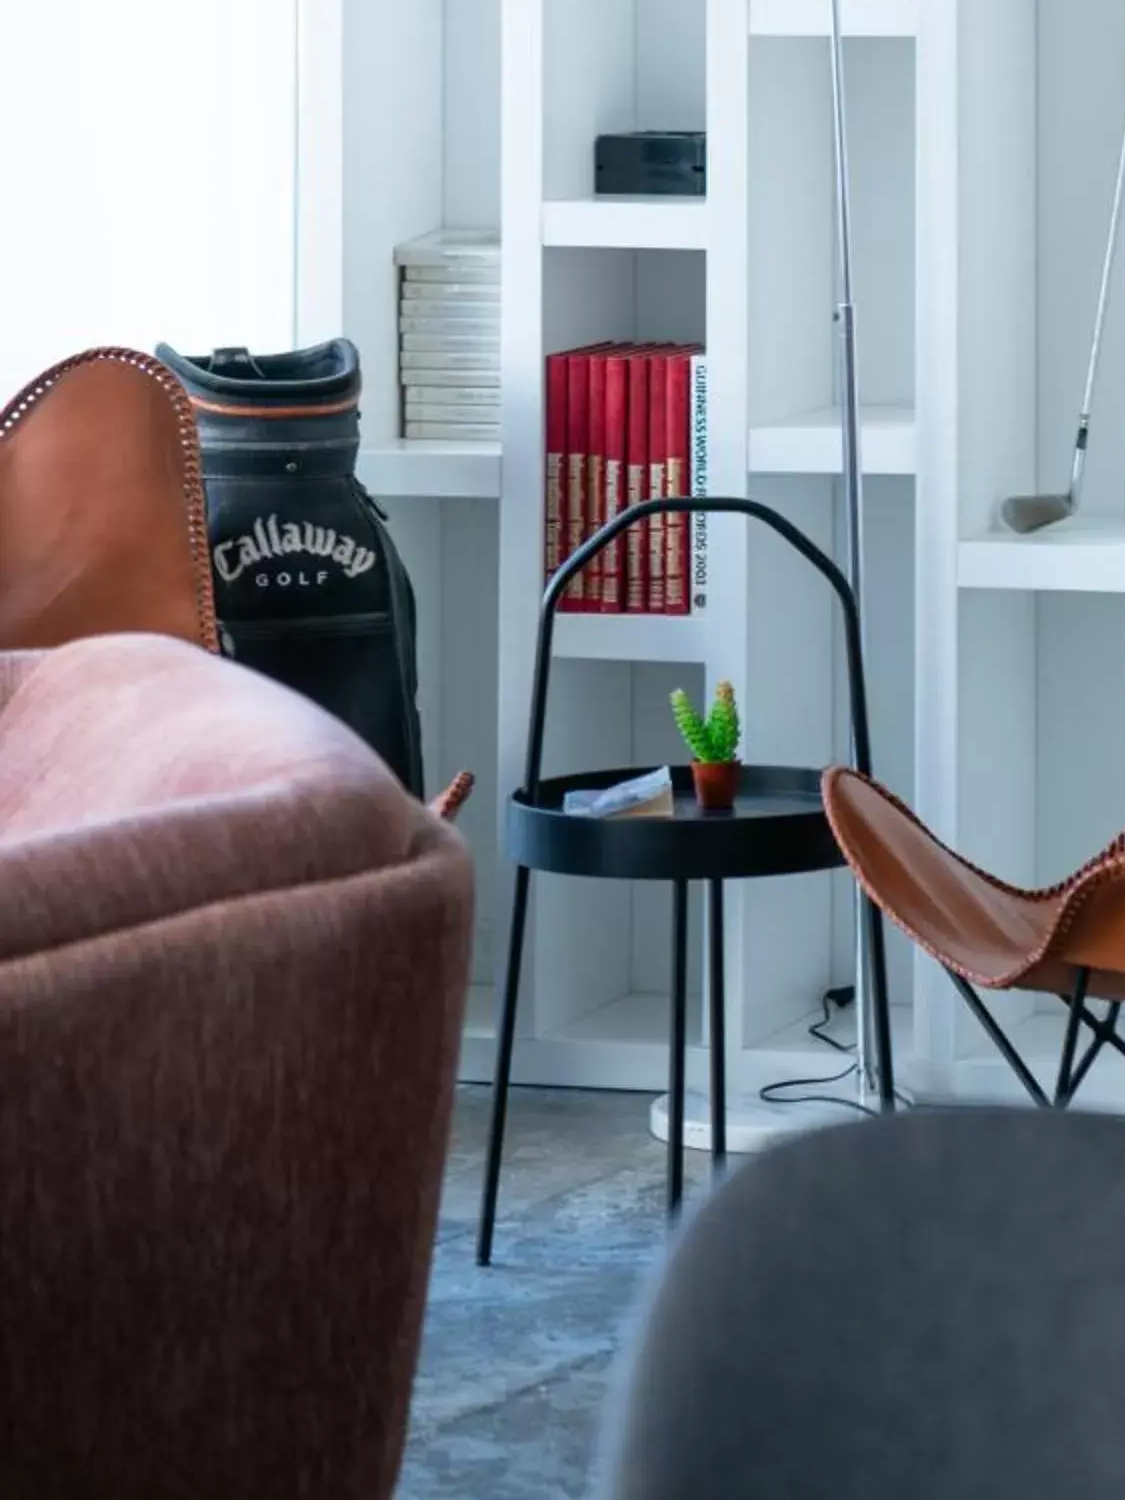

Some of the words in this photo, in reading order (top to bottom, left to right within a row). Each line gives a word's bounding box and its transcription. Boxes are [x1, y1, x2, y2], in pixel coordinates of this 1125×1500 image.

[696, 364, 707, 433] GUINNESS
[696, 435, 707, 485] WORLD
[213, 513, 376, 581] Callaway
[696, 487, 707, 550] RORDS
[255, 572, 328, 587] GOLF
